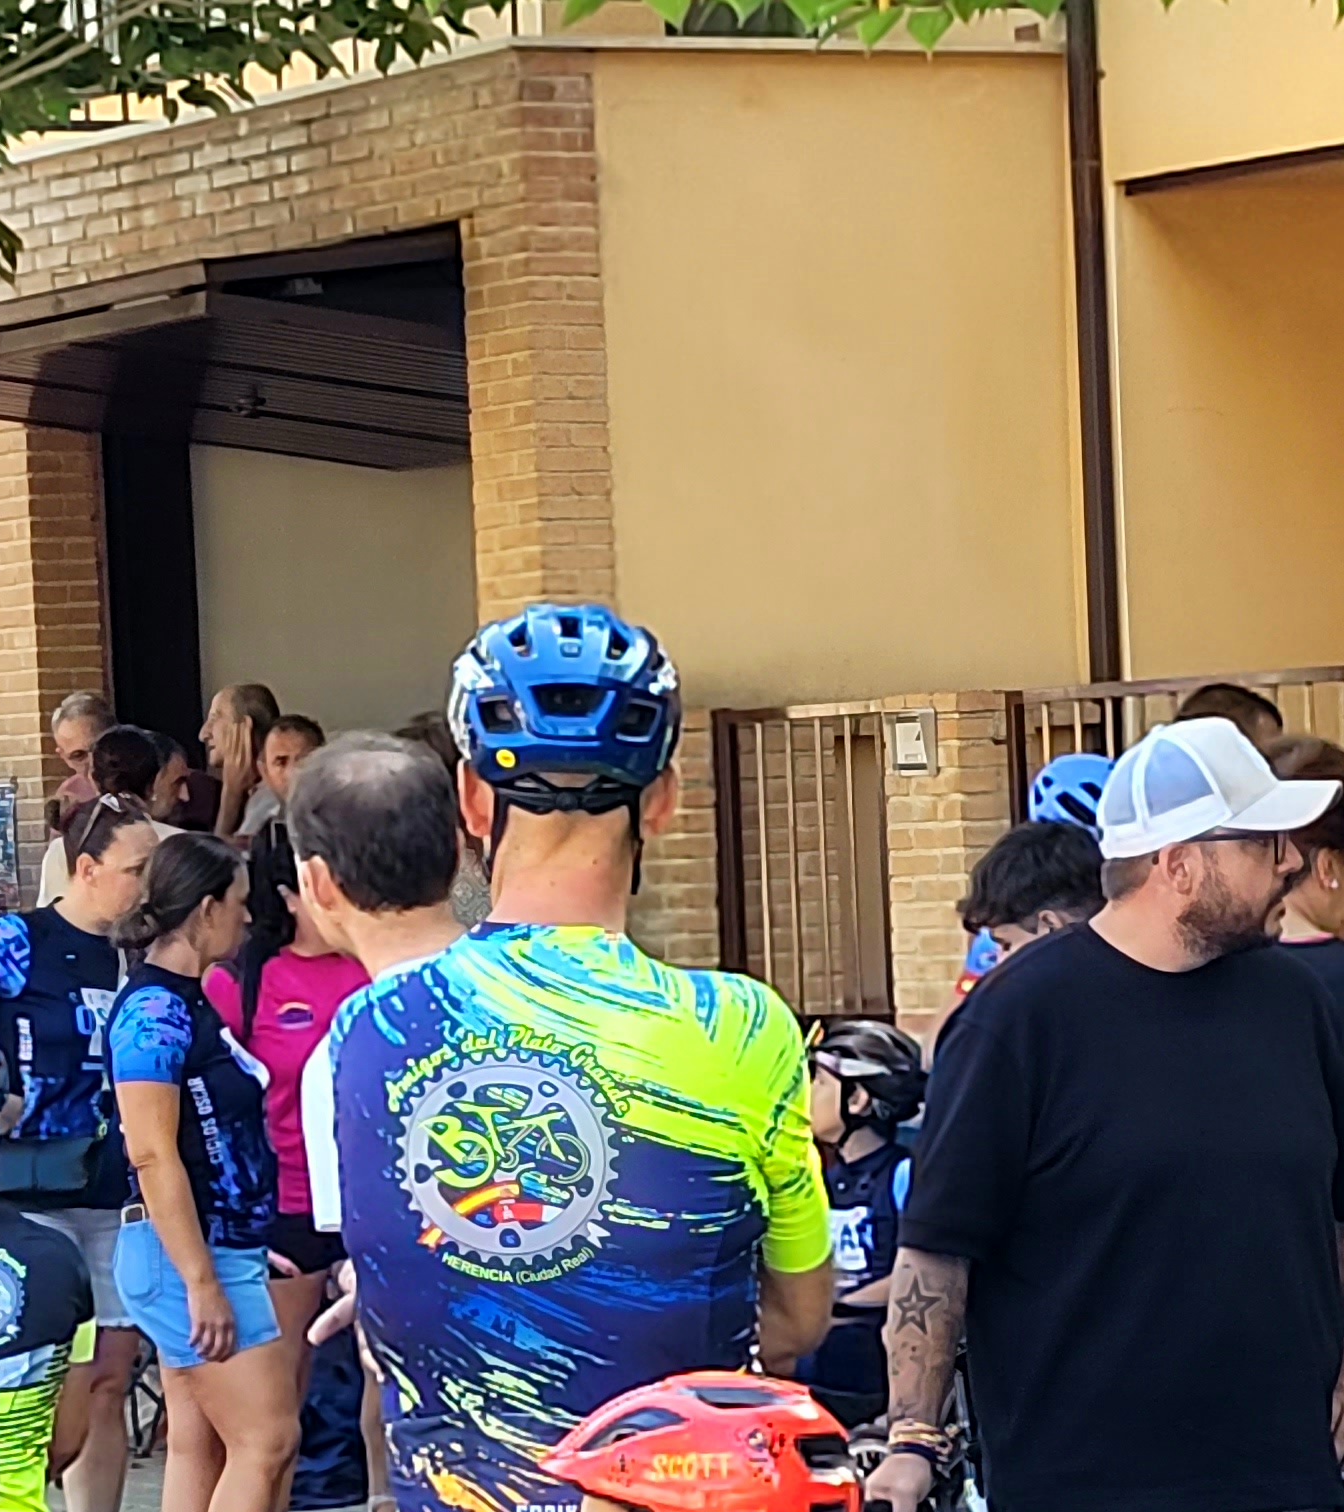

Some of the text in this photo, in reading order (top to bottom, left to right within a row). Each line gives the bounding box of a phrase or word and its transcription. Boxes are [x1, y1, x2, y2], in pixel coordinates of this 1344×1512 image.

[383, 1024, 631, 1117] Amigos del Plato Grande
[187, 1076, 213, 1115] OSCAR
[442, 1252, 515, 1283] HERENCIA
[562, 1246, 596, 1268] Real)
[651, 1453, 732, 1481] SCOTT
